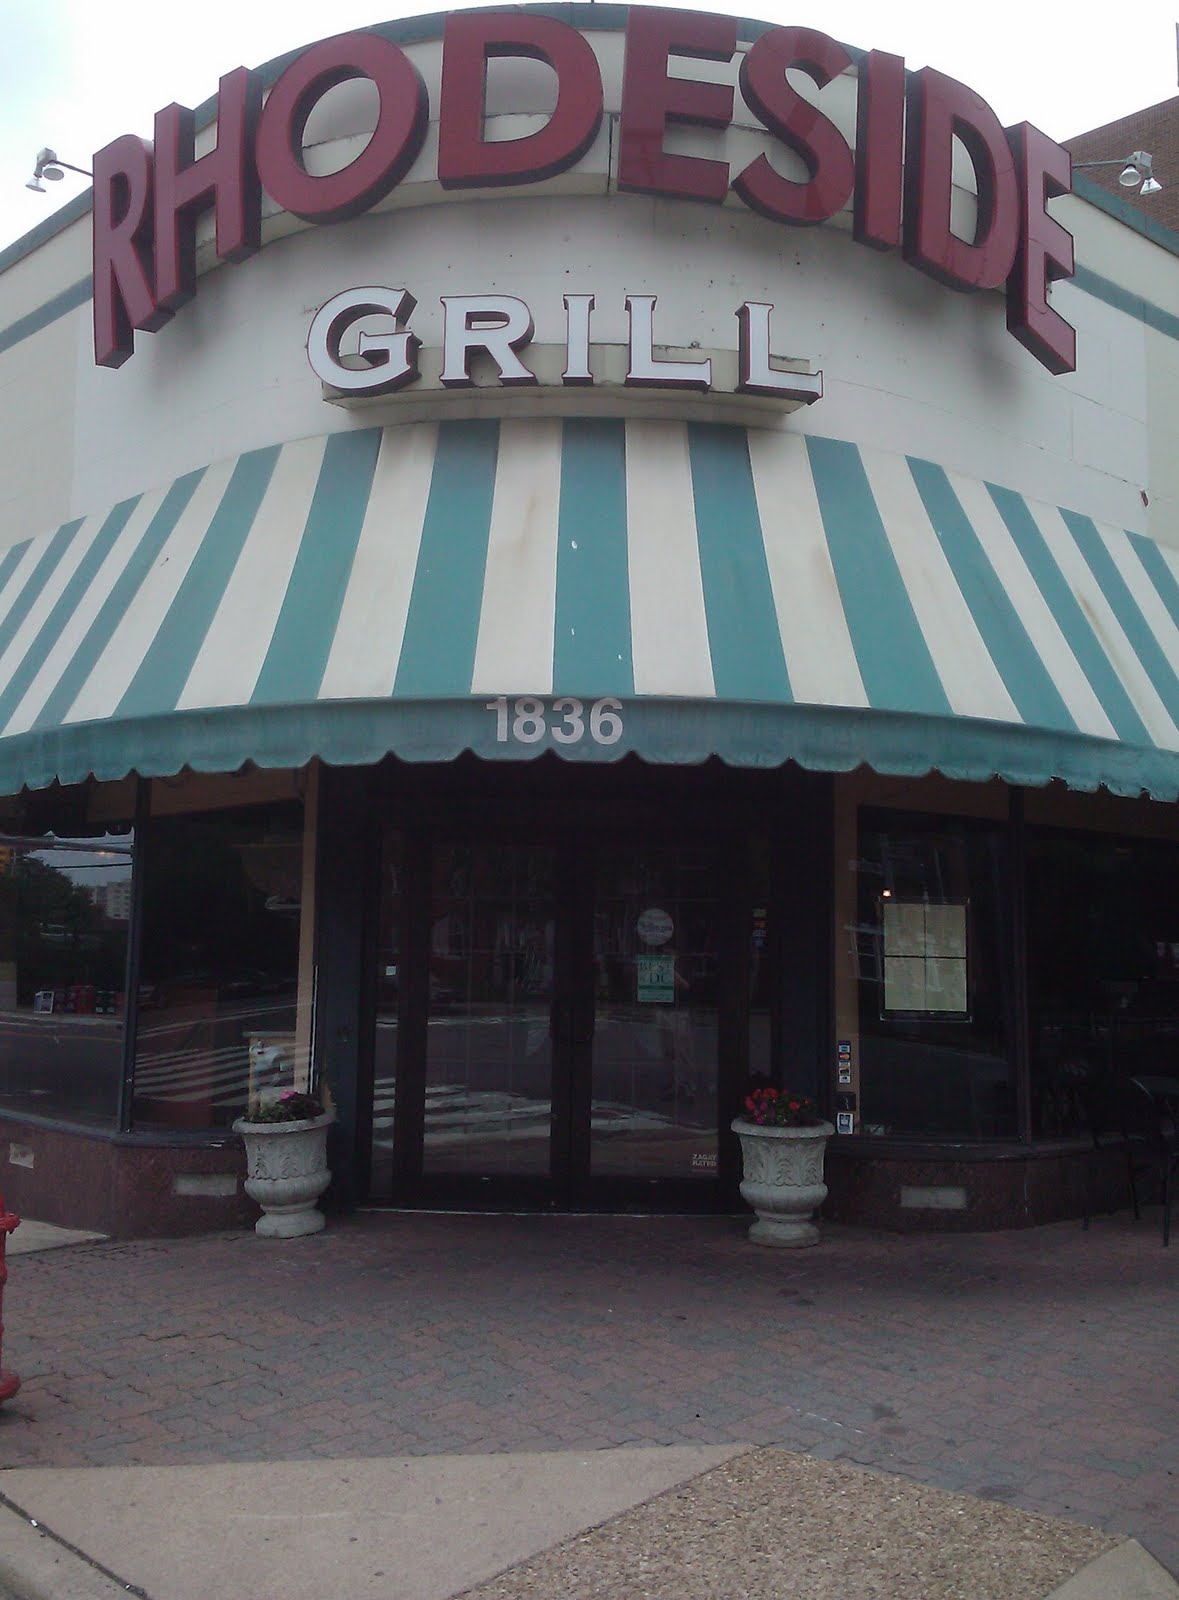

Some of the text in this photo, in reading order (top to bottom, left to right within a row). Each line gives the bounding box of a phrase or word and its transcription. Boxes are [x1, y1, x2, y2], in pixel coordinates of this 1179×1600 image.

[93, 7, 1076, 374] RHODESIDE
[307, 286, 823, 402] GRILL
[486, 696, 624, 745] 1836
